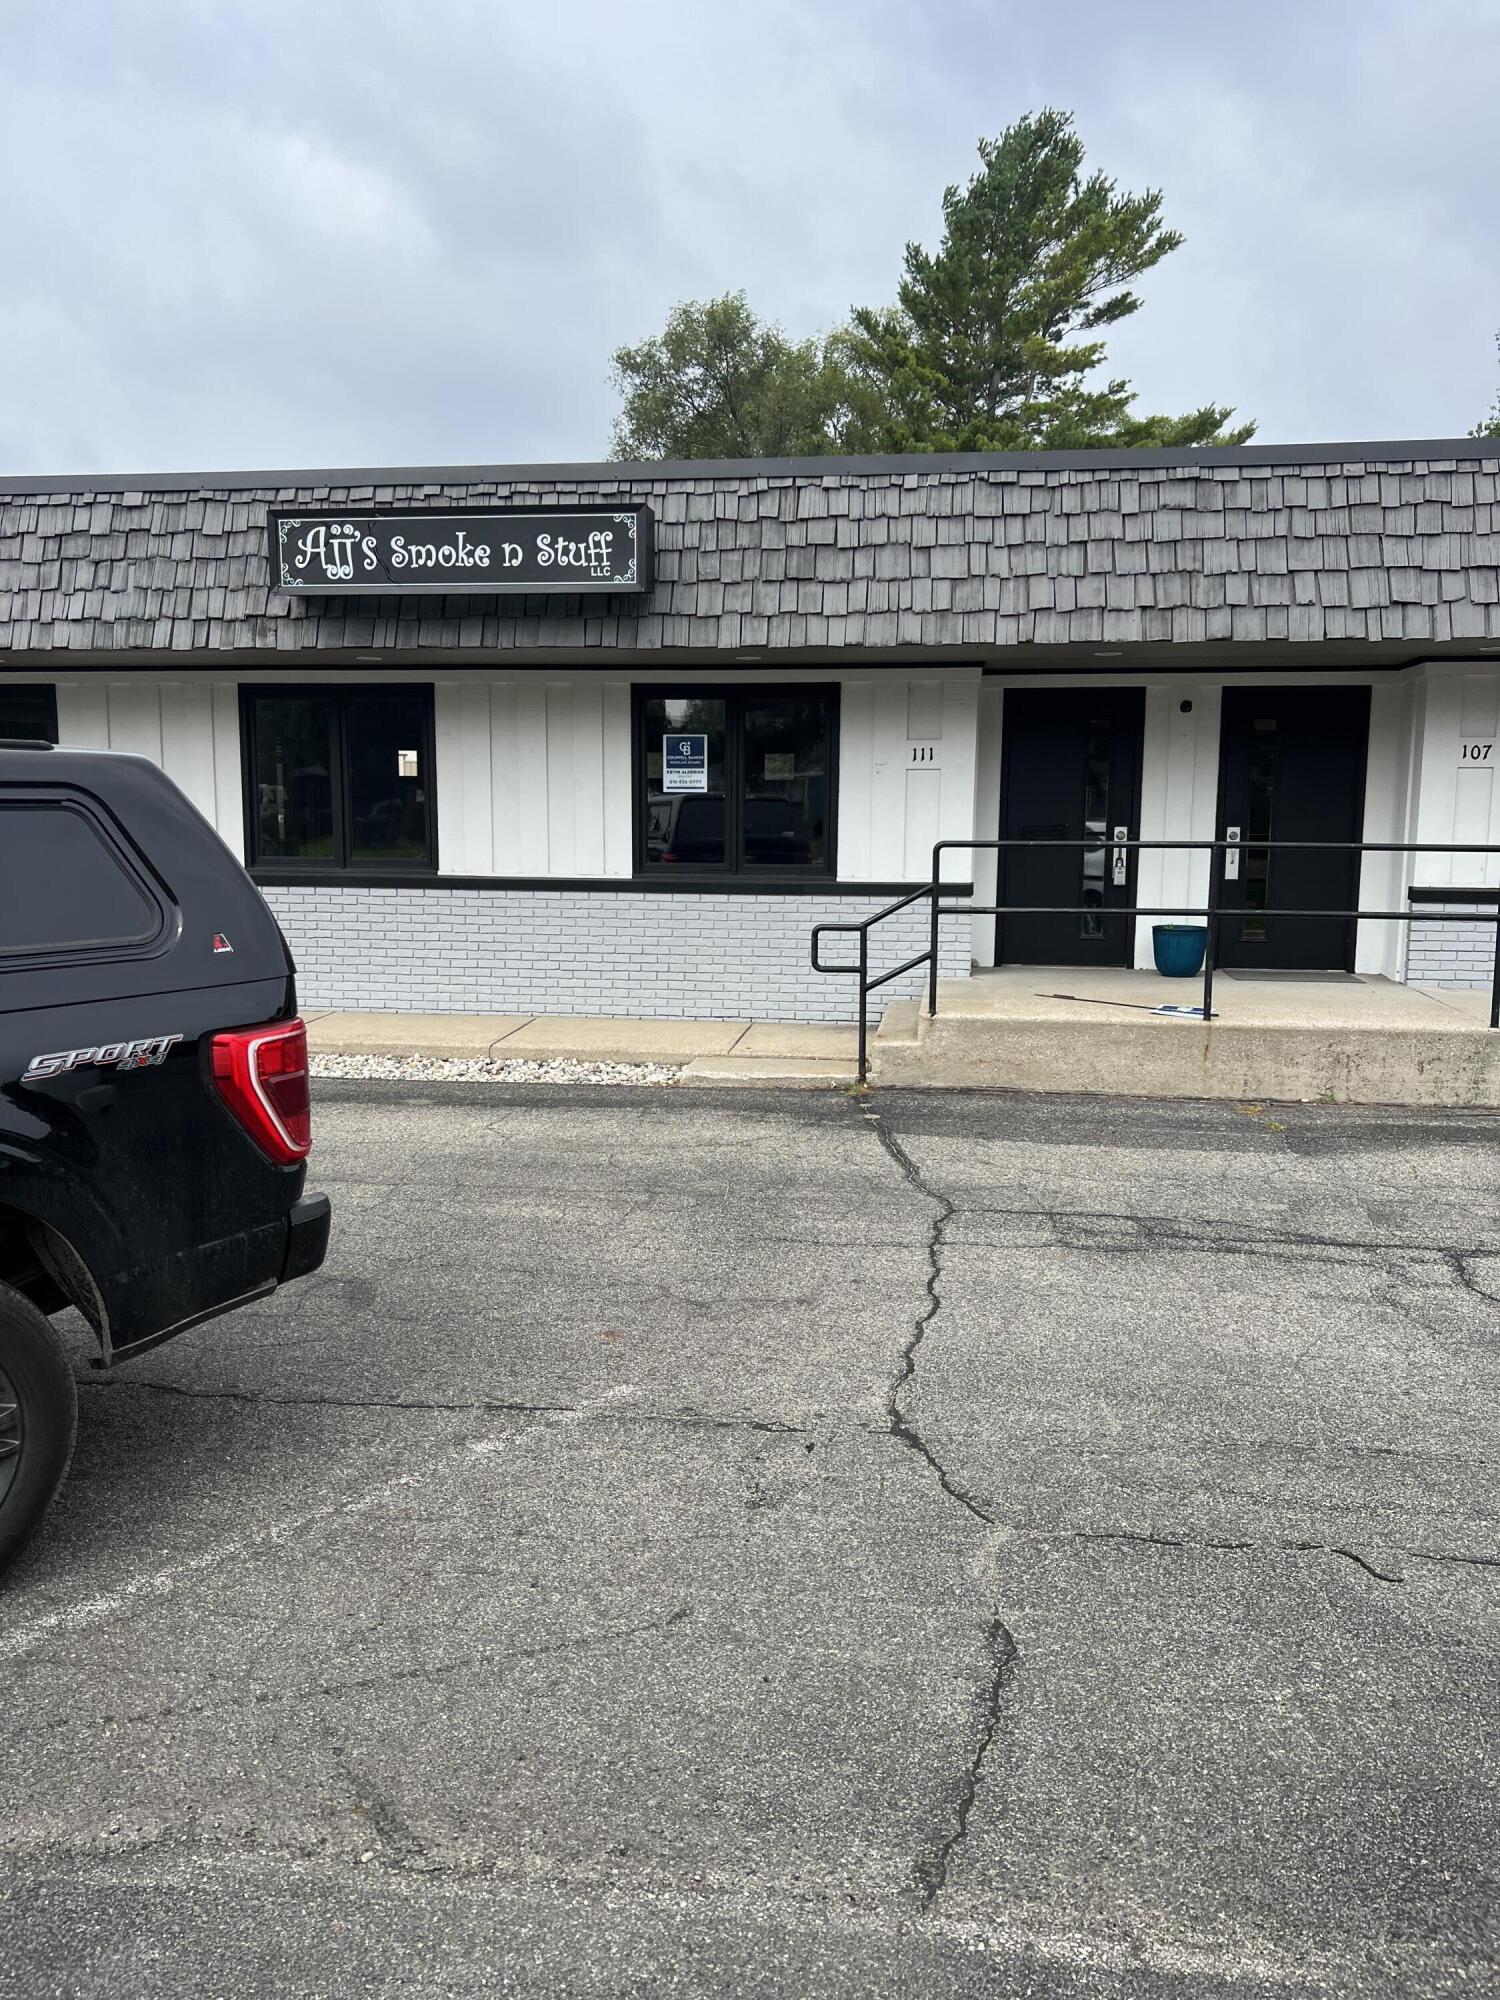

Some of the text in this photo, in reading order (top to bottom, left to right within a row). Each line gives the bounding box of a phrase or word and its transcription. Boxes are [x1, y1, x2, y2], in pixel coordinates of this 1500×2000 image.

[391, 531, 491, 569] Smoke
[502, 542, 523, 567] n
[536, 531, 614, 567] Stuff
[590, 566, 611, 577] LLC
[912, 747, 934, 762] 111
[1462, 744, 1493, 761] 107
[22, 1033, 184, 1082] SPORT
